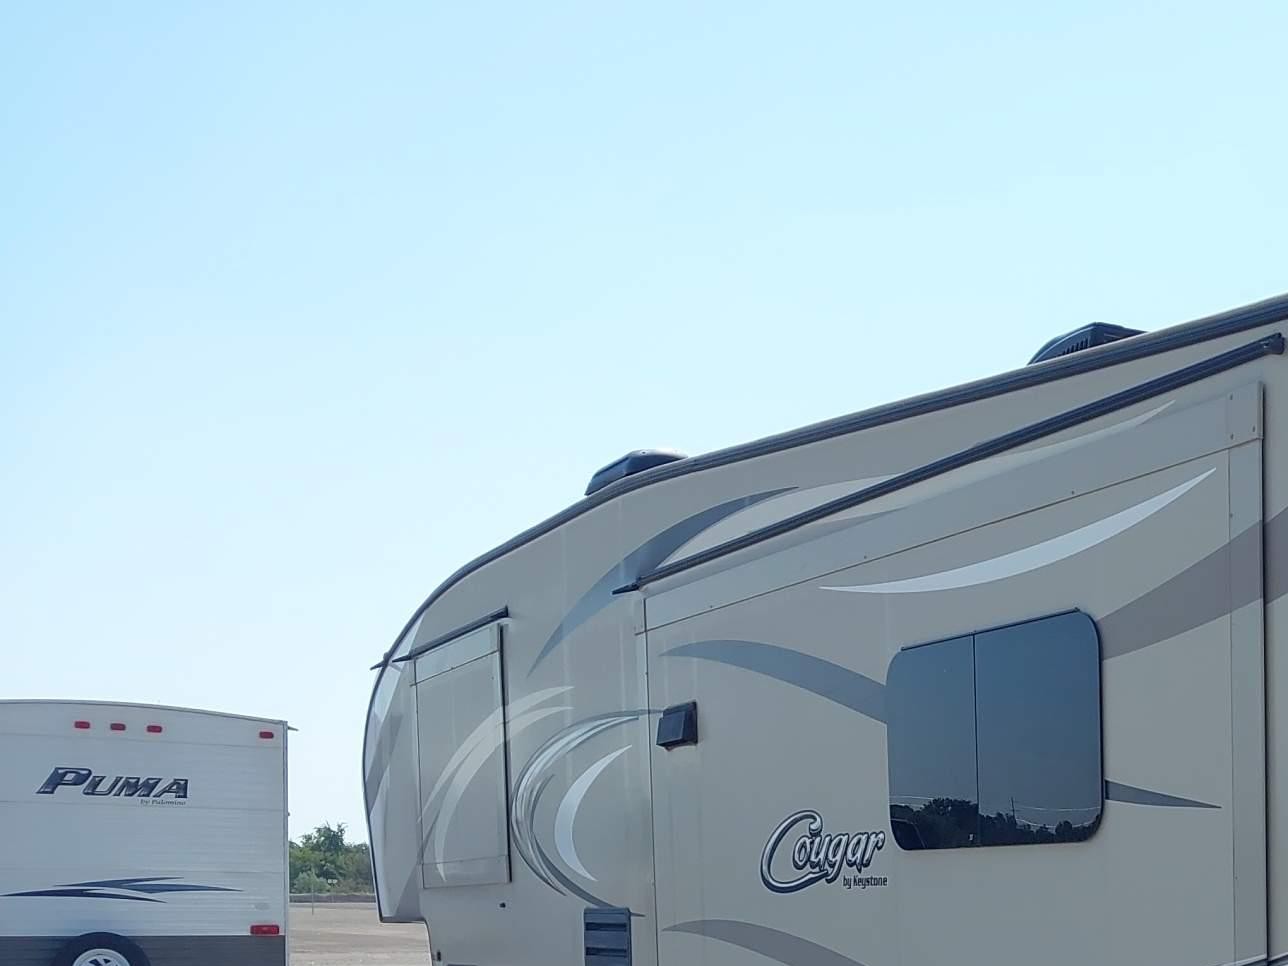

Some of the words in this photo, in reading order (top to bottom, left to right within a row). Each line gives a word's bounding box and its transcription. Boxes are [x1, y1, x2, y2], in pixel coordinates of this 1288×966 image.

[760, 809, 886, 894] Cougar
[843, 875, 852, 889] by
[853, 875, 888, 889] Keystone
